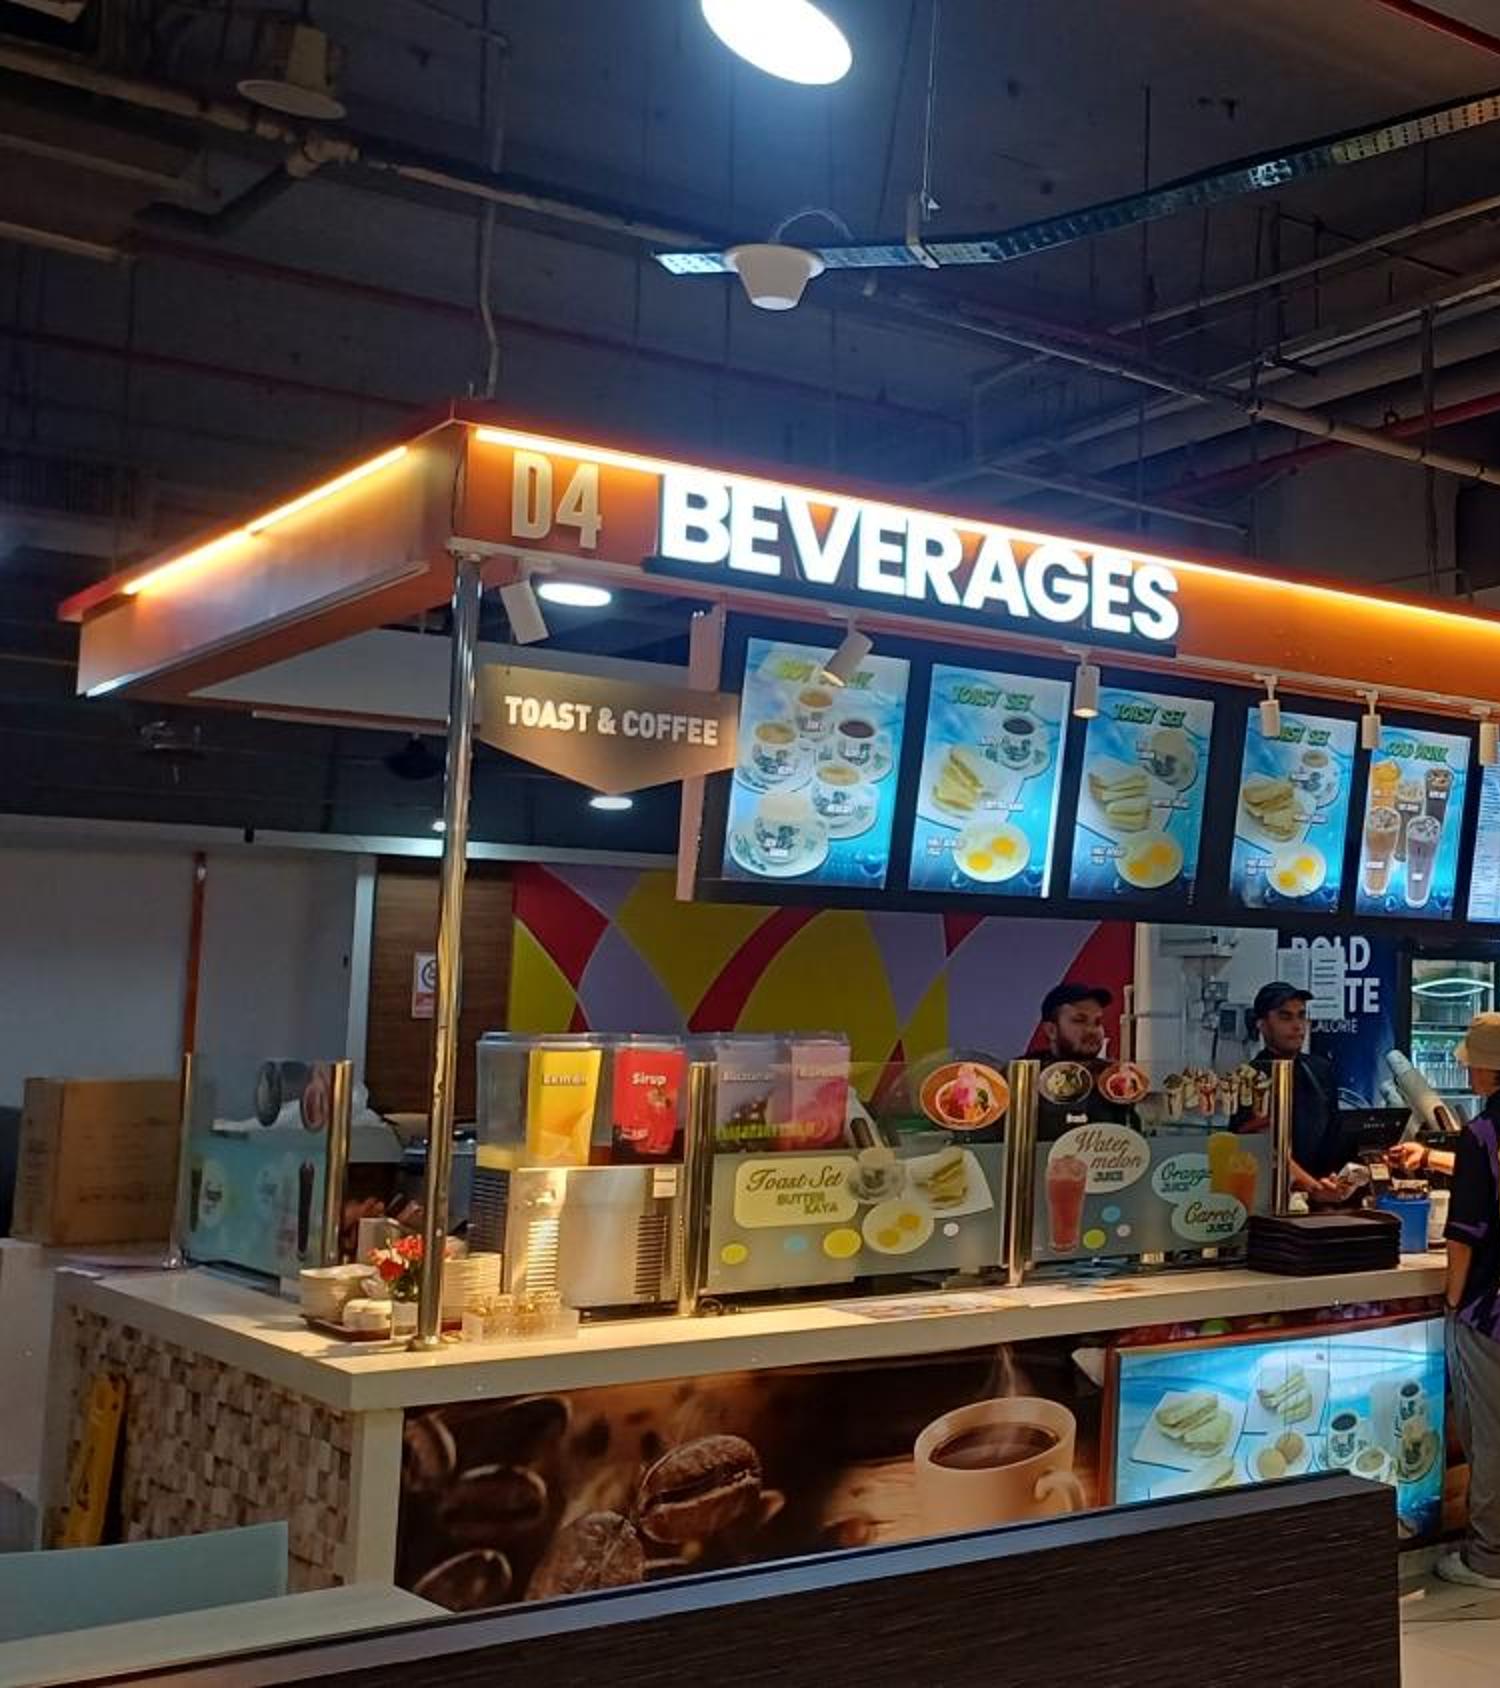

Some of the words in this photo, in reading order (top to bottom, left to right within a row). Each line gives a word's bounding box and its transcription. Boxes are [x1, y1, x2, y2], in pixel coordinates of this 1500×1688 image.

[511, 451, 602, 549] D4
[660, 473, 1180, 640] BEVERAGES
[505, 696, 592, 732] TOAST
[598, 707, 616, 735] &
[622, 710, 719, 746] COFFEE
[631, 1072, 667, 1086] Sirup
[1075, 1129, 1130, 1153] Water
[1090, 1148, 1142, 1169] melon
[746, 1167, 806, 1191] Toast
[809, 1165, 842, 1188] Set
[1185, 1201, 1240, 1225] Carrot
